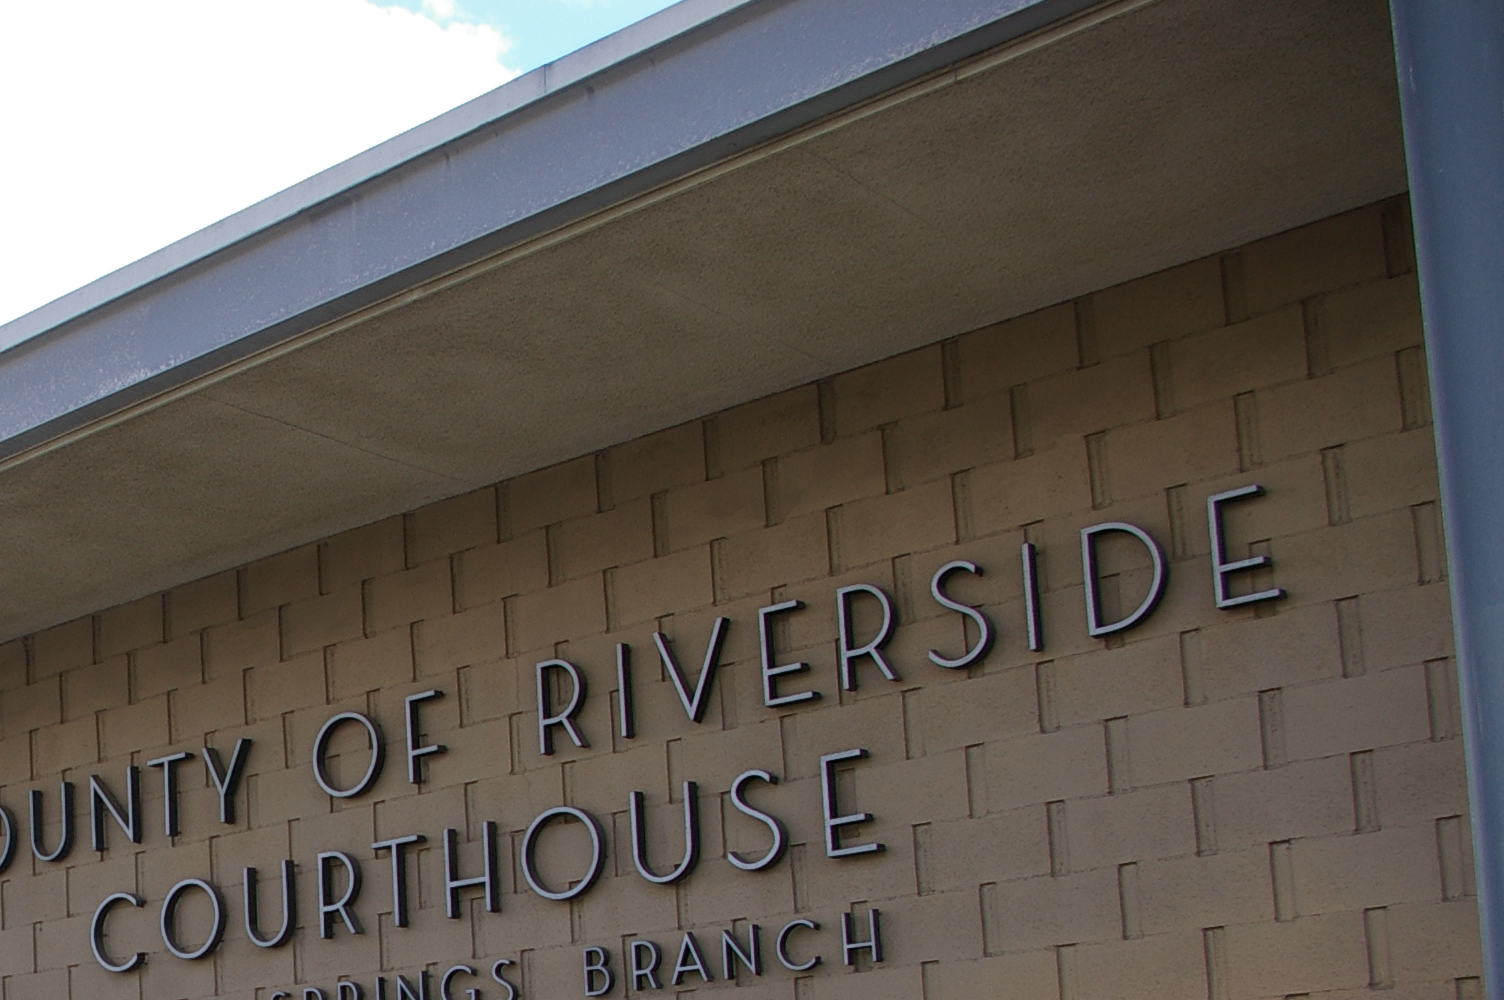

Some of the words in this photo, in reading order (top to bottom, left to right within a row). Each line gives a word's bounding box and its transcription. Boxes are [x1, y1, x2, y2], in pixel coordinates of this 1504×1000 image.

[312, 690, 448, 798] OF
[536, 484, 1287, 756] RIVERSIDE
[90, 748, 885, 972] COURTHOUSE
[583, 909, 884, 998] BRANCH
